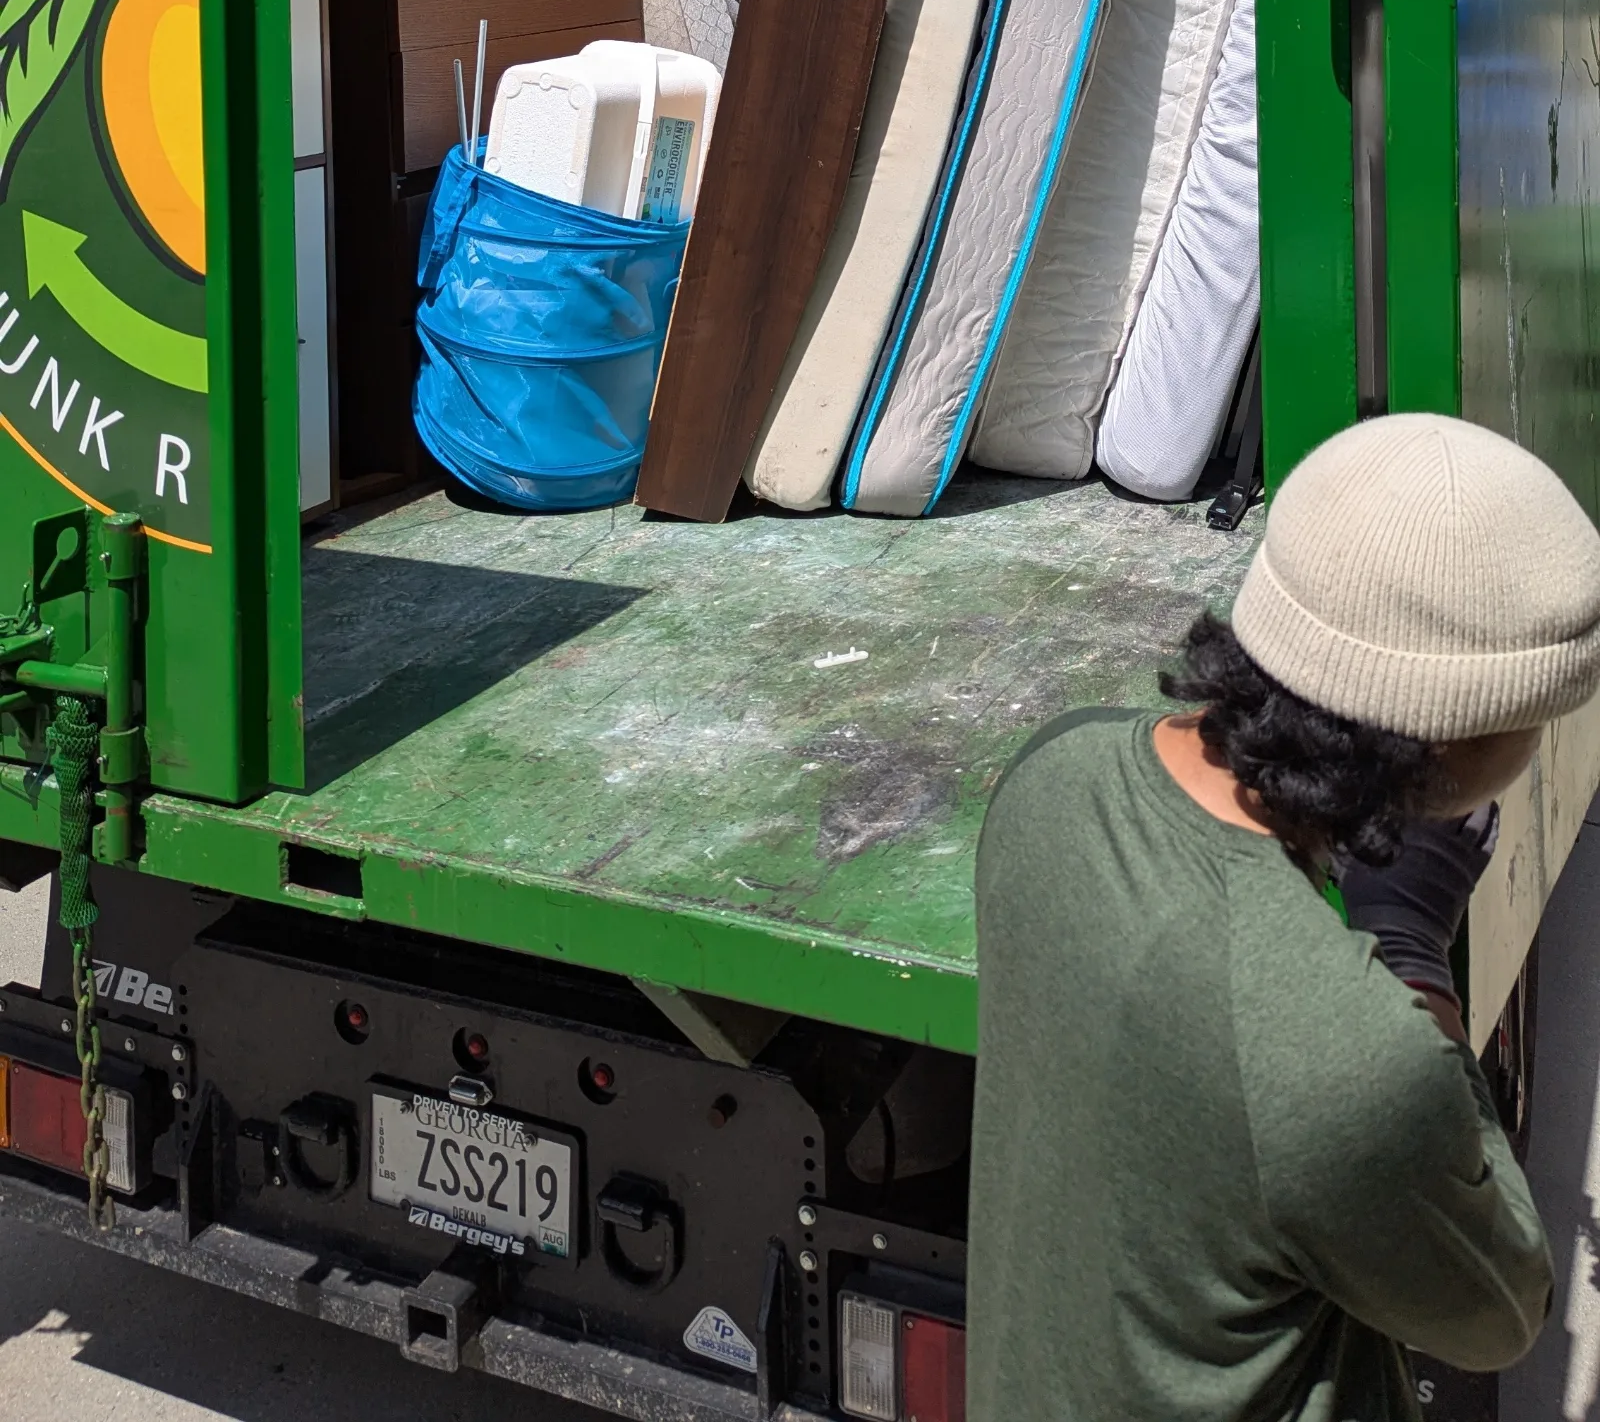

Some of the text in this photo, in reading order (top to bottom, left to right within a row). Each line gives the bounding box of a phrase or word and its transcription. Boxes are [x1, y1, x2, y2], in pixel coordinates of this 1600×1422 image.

[664, 120, 685, 195] ENVIROCOOLER
[0, 291, 125, 471] UNK
[114, 966, 174, 1015] Be
[412, 1094, 524, 1133] DRIVEN TO SERVE
[415, 1105, 529, 1153] GEORGIA
[379, 1168, 397, 1181] LBS
[416, 1129, 558, 1222] ZSS219
[429, 1211, 525, 1256] Bergey's
[452, 1205, 487, 1228] DEKALB
[543, 1232, 563, 1246] AUG
